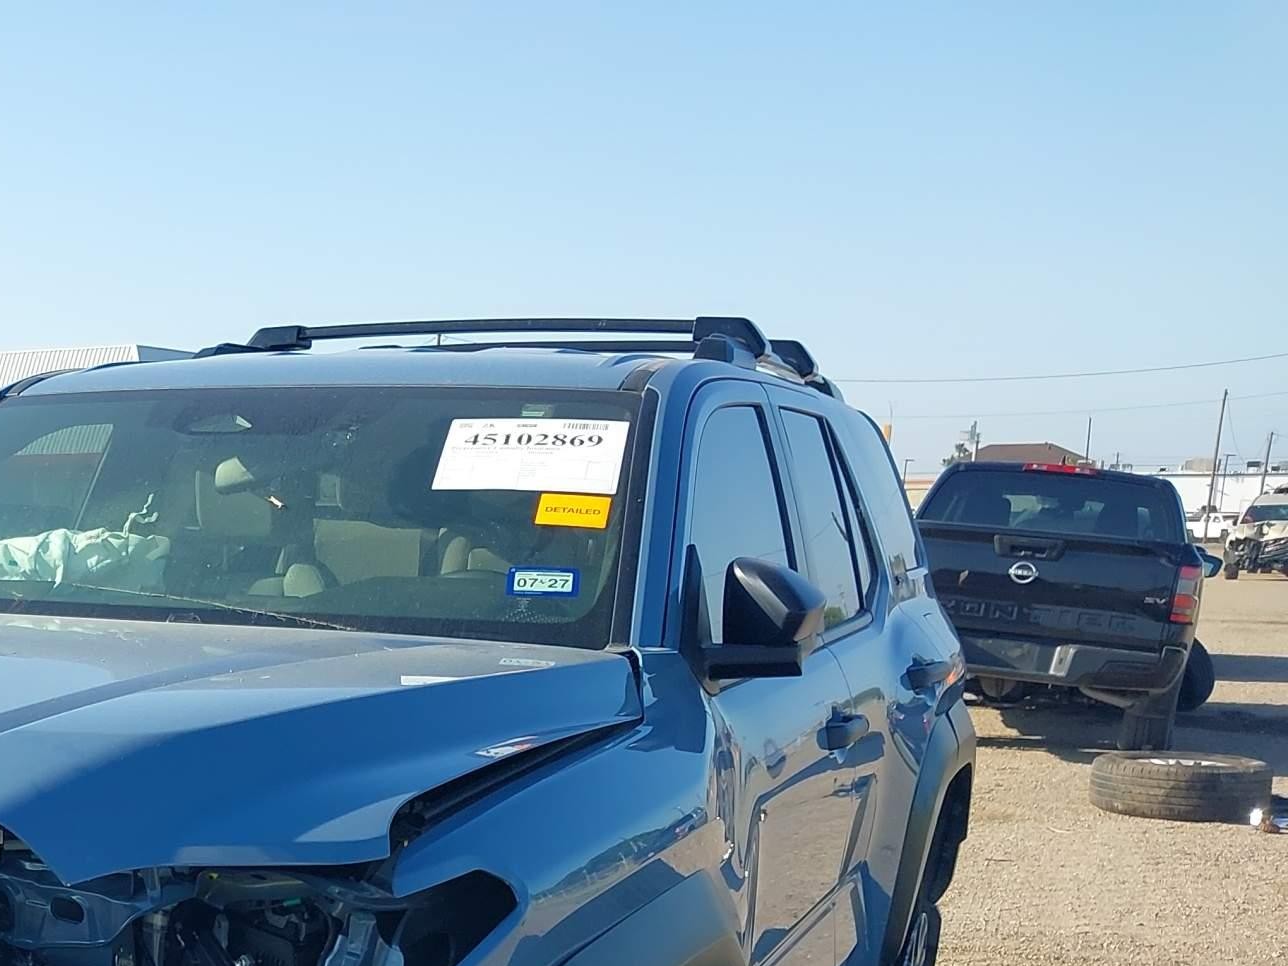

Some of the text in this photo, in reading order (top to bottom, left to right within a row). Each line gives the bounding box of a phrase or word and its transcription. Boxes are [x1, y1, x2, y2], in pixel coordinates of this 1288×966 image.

[464, 432, 604, 448] 45102869
[544, 506, 602, 516] DETAILED
[516, 577, 570, 589] 07 27
